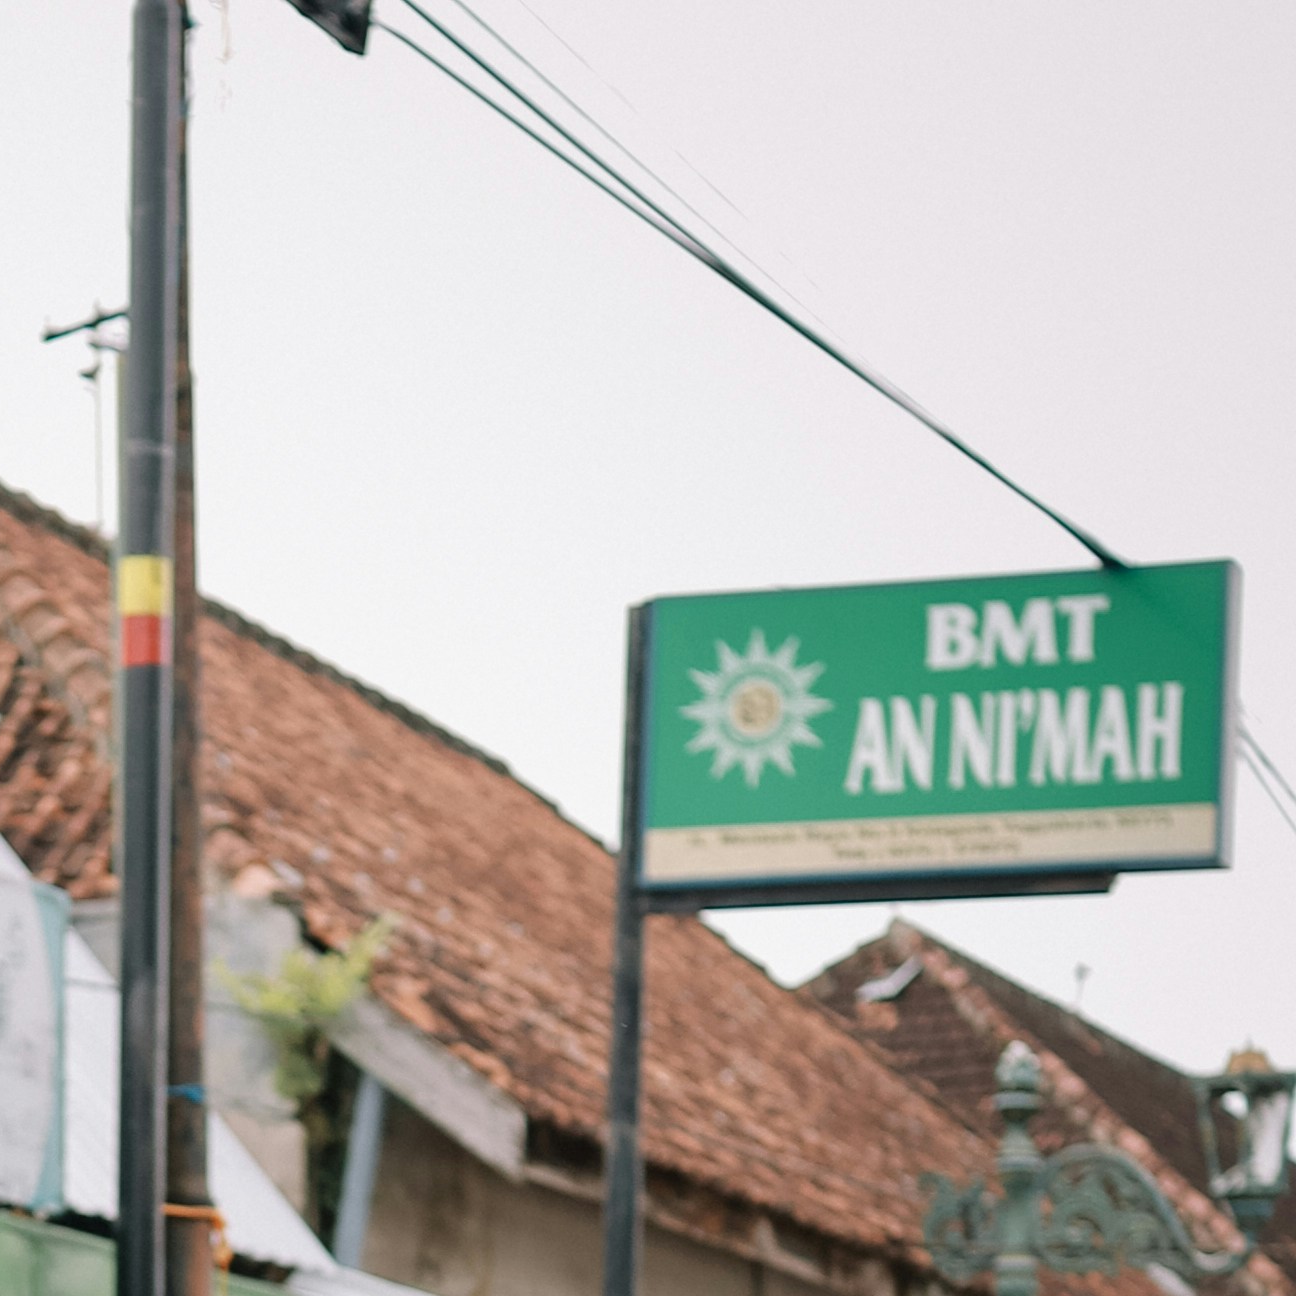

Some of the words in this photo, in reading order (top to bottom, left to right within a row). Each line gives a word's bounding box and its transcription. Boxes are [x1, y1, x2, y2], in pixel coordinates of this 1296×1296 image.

[924, 594, 1111, 671] BMT
[844, 694, 937, 795] AN
[947, 681, 1185, 789] NI'MAH
